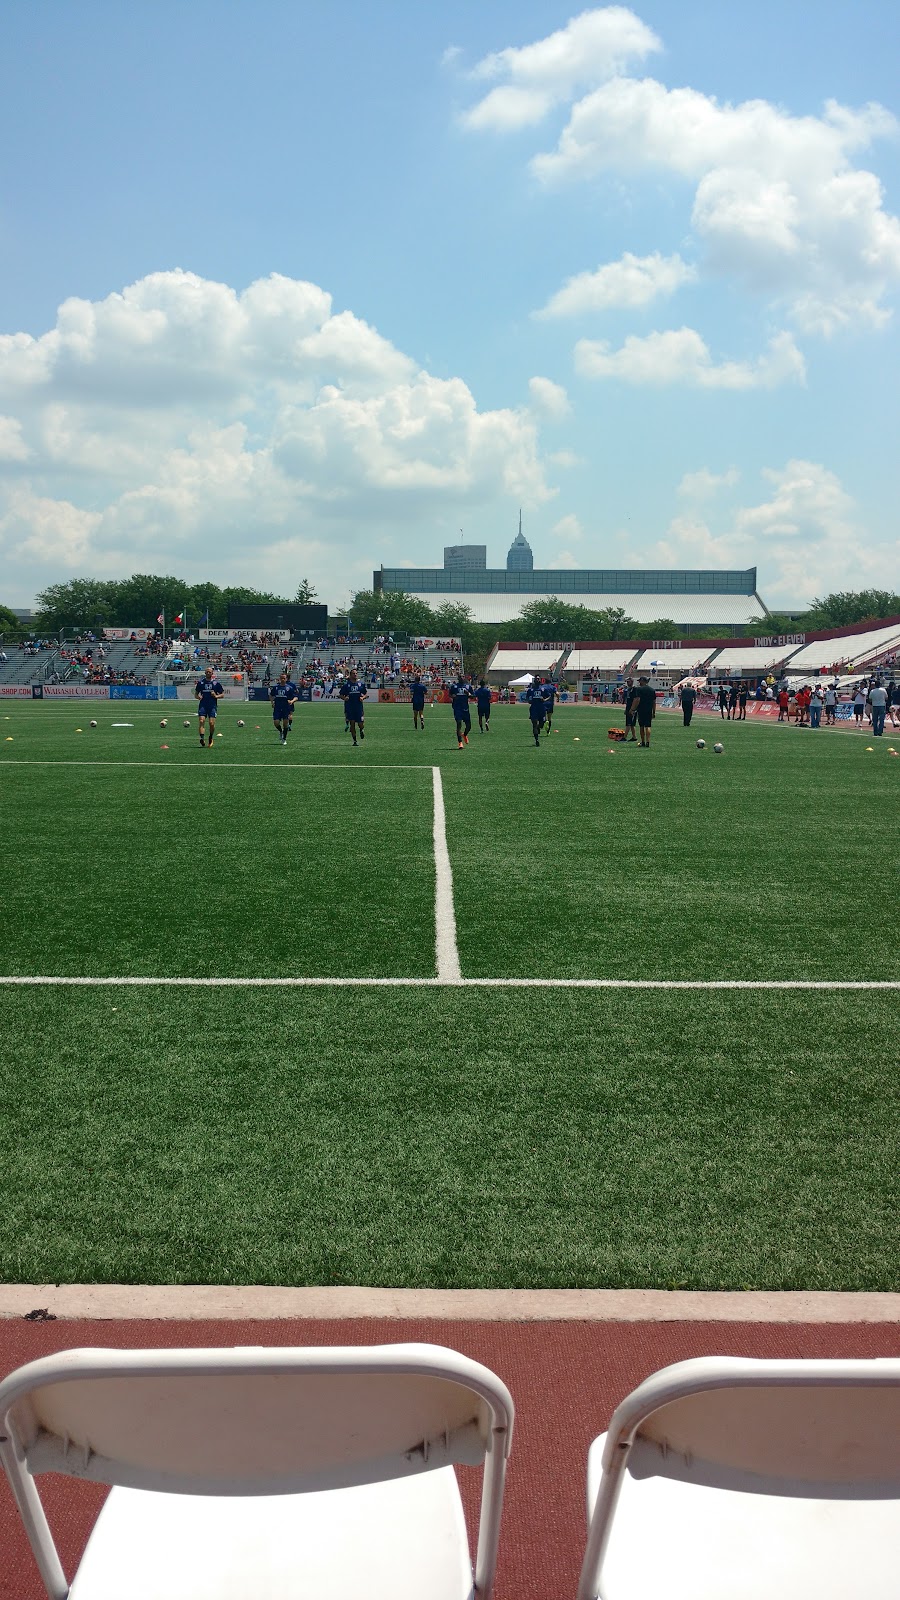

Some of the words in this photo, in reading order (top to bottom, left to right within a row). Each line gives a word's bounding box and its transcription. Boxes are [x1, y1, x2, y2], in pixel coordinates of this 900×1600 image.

[652, 640, 682, 649] IUPUI
[753, 636, 773, 647] INDY
[778, 633, 806, 646] ELEVEN
[526, 642, 545, 650] INDY
[550, 642, 576, 650] ELEVEN
[43, 686, 75, 696] WABASH
[75, 687, 110, 696] COLLEGE
